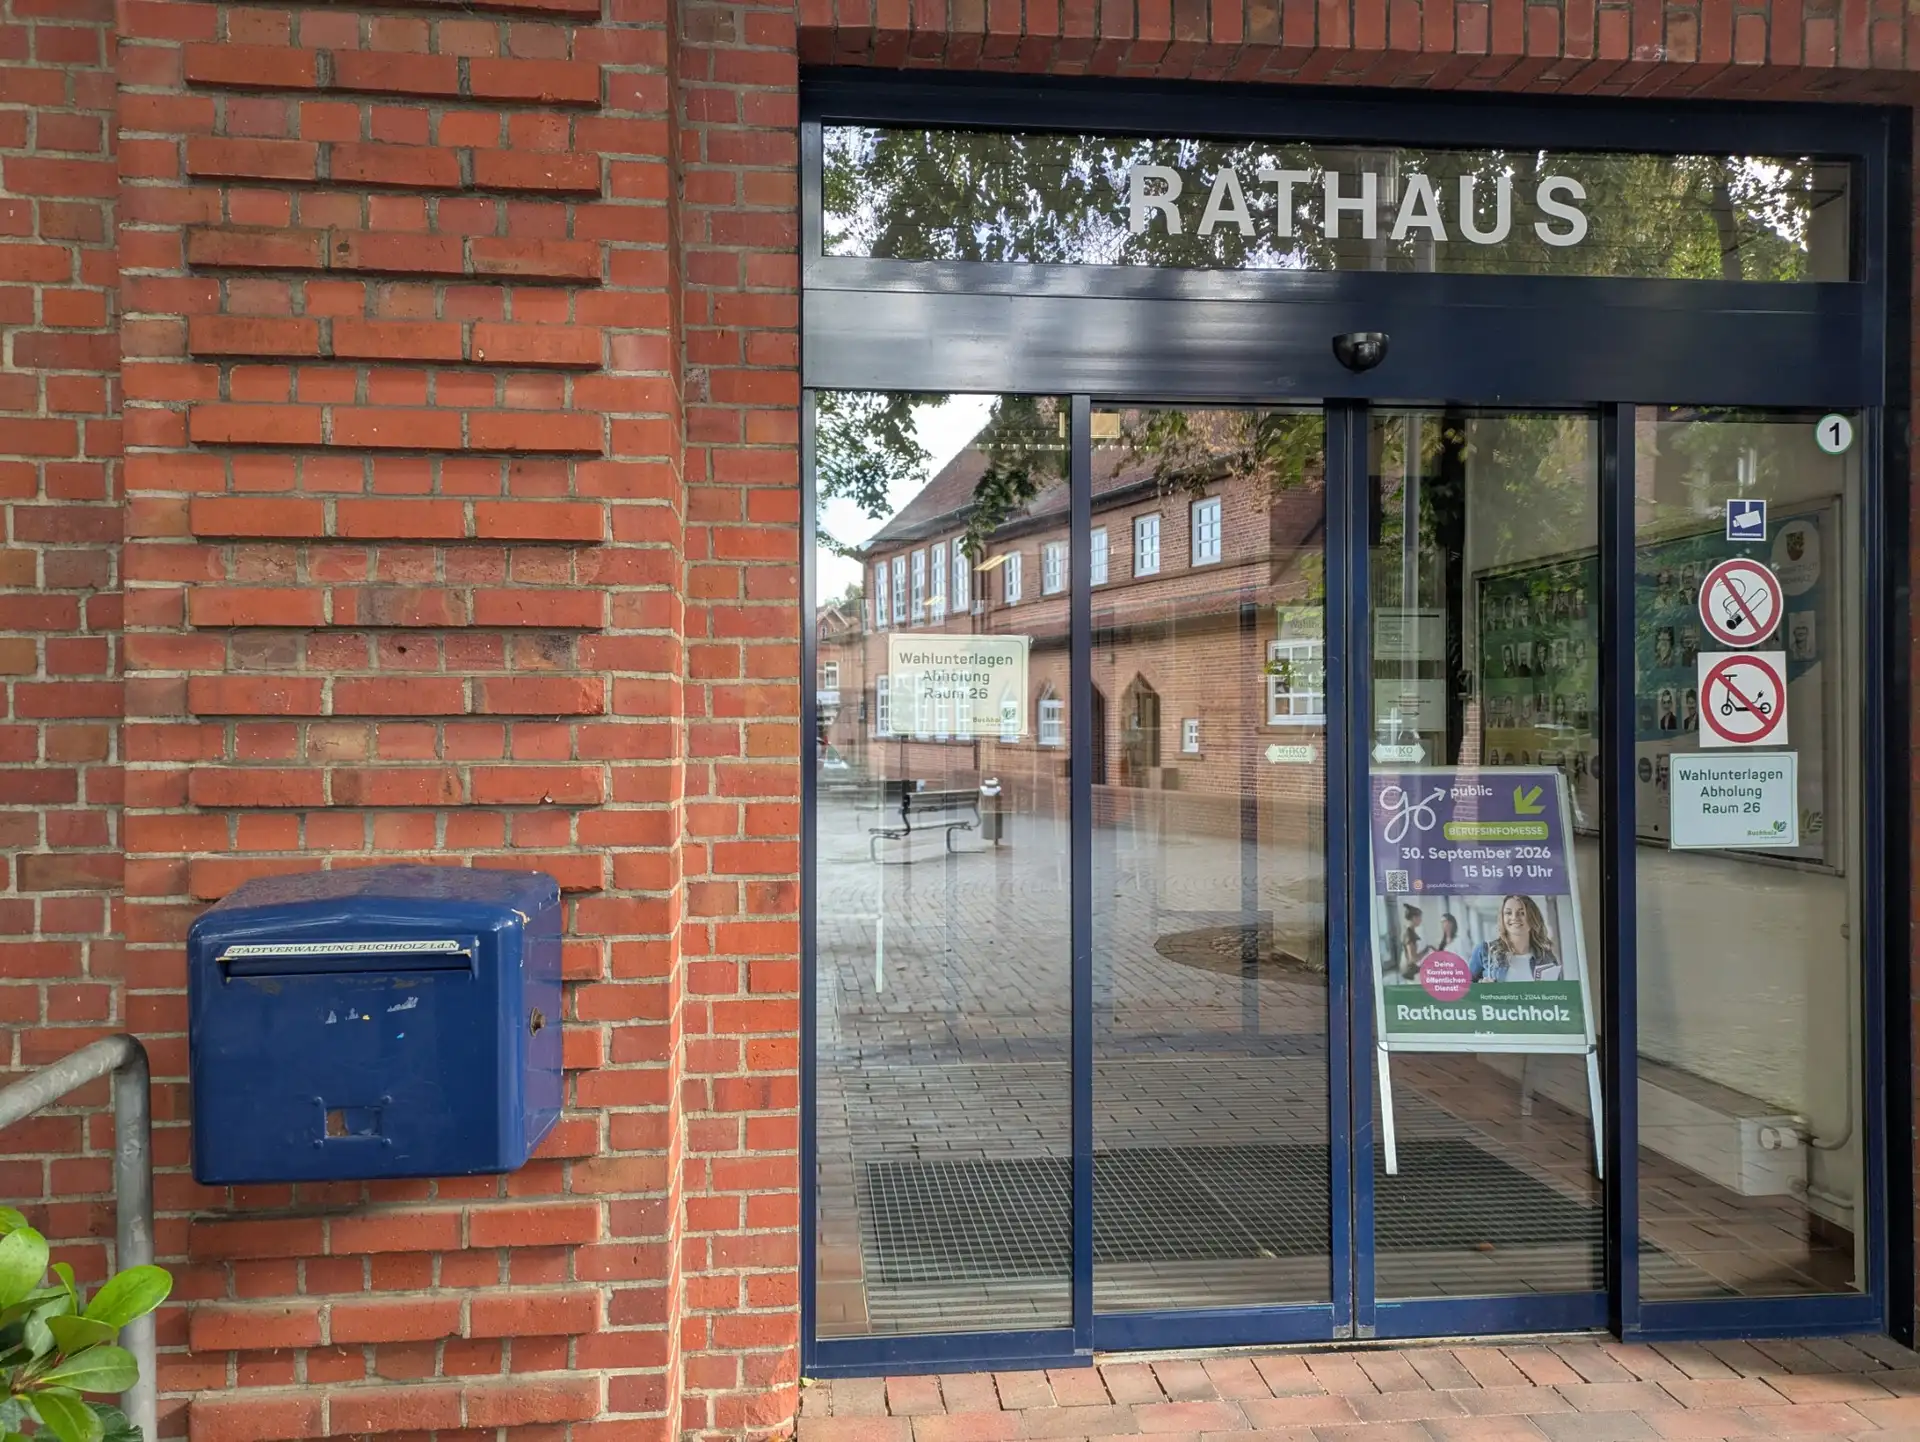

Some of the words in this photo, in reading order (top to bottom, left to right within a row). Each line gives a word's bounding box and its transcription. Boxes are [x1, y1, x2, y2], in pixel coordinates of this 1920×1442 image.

[1129, 165, 1588, 246] RATHAUS
[1829, 422, 1840, 446] 1
[899, 652, 1013, 668] Wahlunterlagen
[922, 669, 991, 685] Abholung
[924, 687, 964, 700] Raum
[969, 687, 988, 699] 26
[1679, 768, 1783, 783] Wahlunterlagen
[1450, 785, 1493, 799] public
[1700, 785, 1763, 799] Abholung
[1379, 785, 1438, 844] go
[1702, 803, 1739, 814] Raum
[1743, 802, 1761, 813] 26
[1448, 826, 1544, 836] BERUFSINFOMESSE
[1401, 847, 1425, 859] 30.
[1428, 846, 1512, 861] September
[1515, 846, 1551, 859] 2026
[1462, 866, 1479, 878] 15
[1482, 865, 1504, 878] bis
[1507, 865, 1523, 878] 19
[1526, 865, 1553, 878] Uhr
[227, 944, 353, 954] STADTVERWALTUNG
[357, 943, 426, 951] BUCHHOLZ
[1397, 1004, 1477, 1021] Rathaus
[1481, 1004, 1570, 1021] Buchholz
